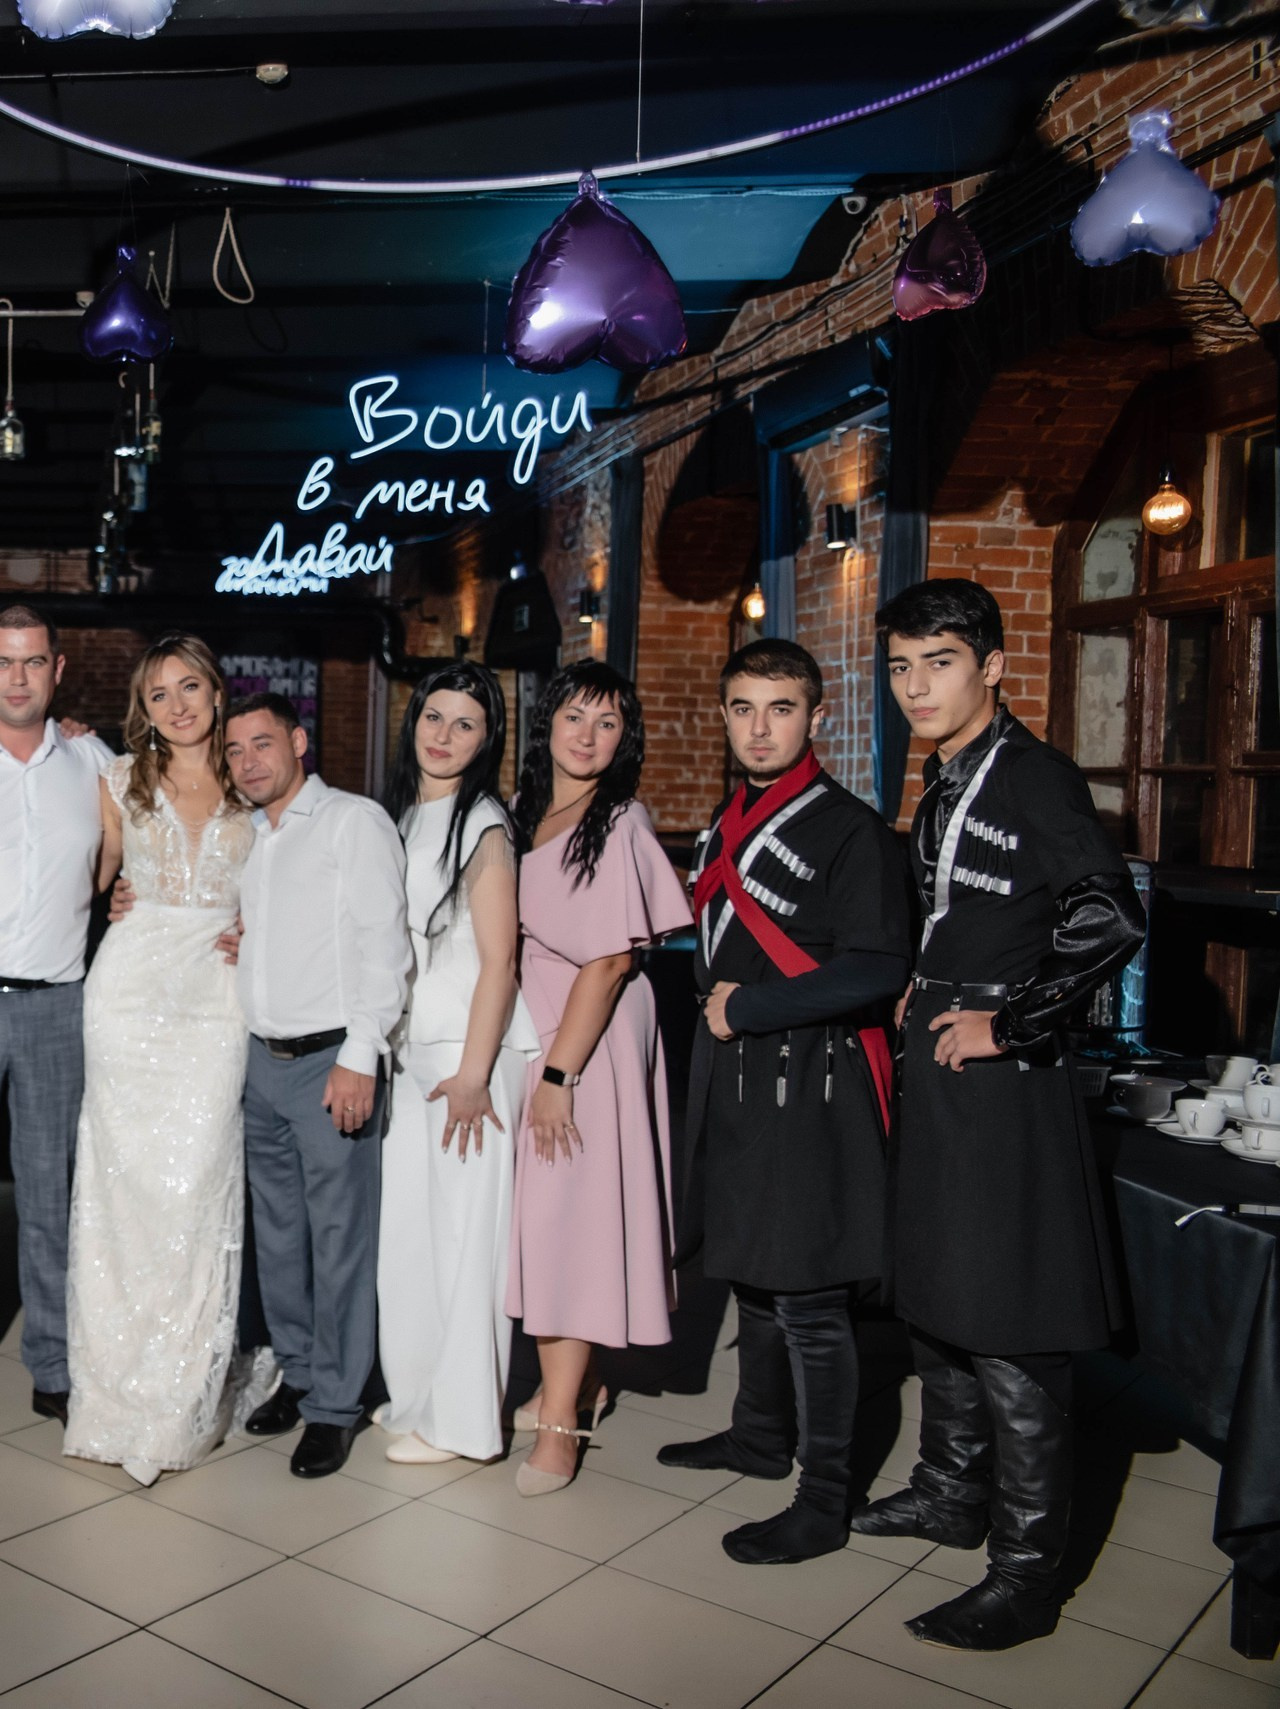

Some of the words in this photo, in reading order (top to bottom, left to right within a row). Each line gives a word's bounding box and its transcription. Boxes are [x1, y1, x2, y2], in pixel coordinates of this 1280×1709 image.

[348, 374, 592, 485] Войди
[296, 456, 335, 512] в
[354, 478, 491, 520] меня
[233, 521, 395, 590] Давай
